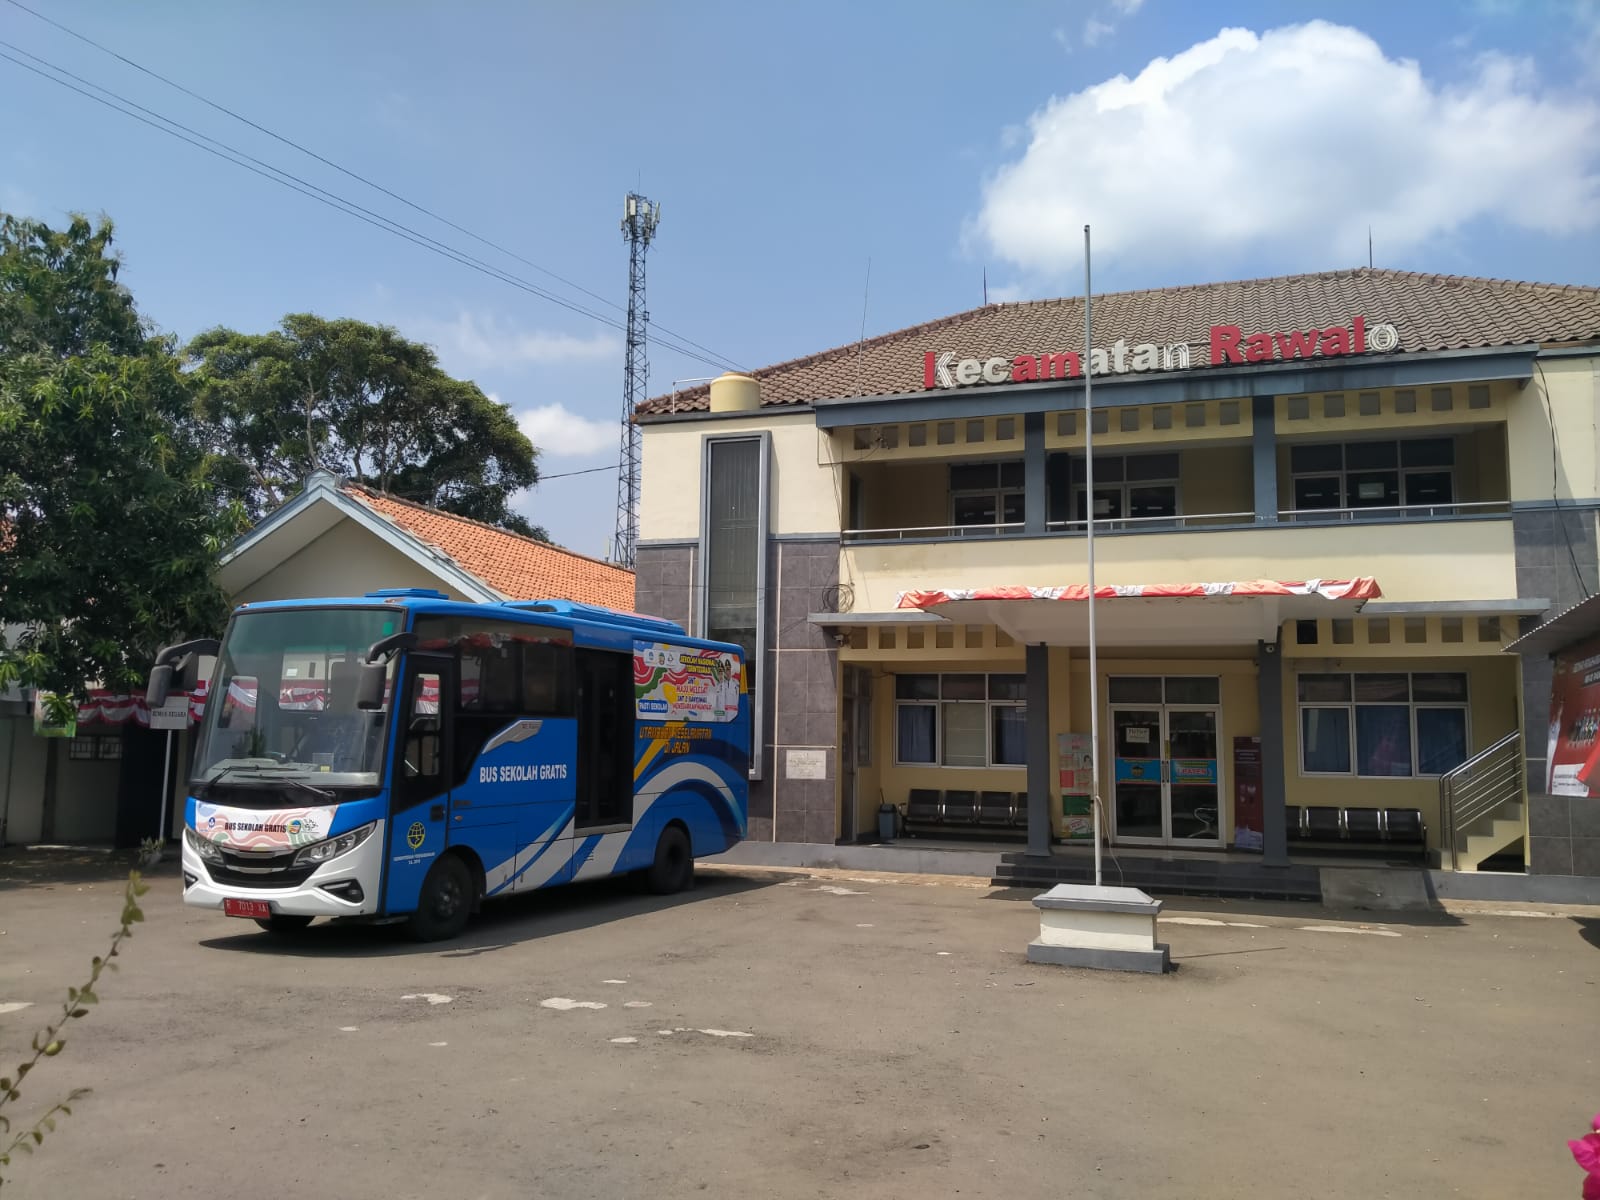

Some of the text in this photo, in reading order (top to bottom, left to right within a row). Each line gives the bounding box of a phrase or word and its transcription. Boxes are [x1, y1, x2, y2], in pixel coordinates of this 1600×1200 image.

[924, 316, 1399, 388] Kecamatan Rawalo
[480, 764, 567, 783] BUS SEKOLAH GRATIS
[224, 822, 287, 833] BUS SEKOLAH GRATIS
